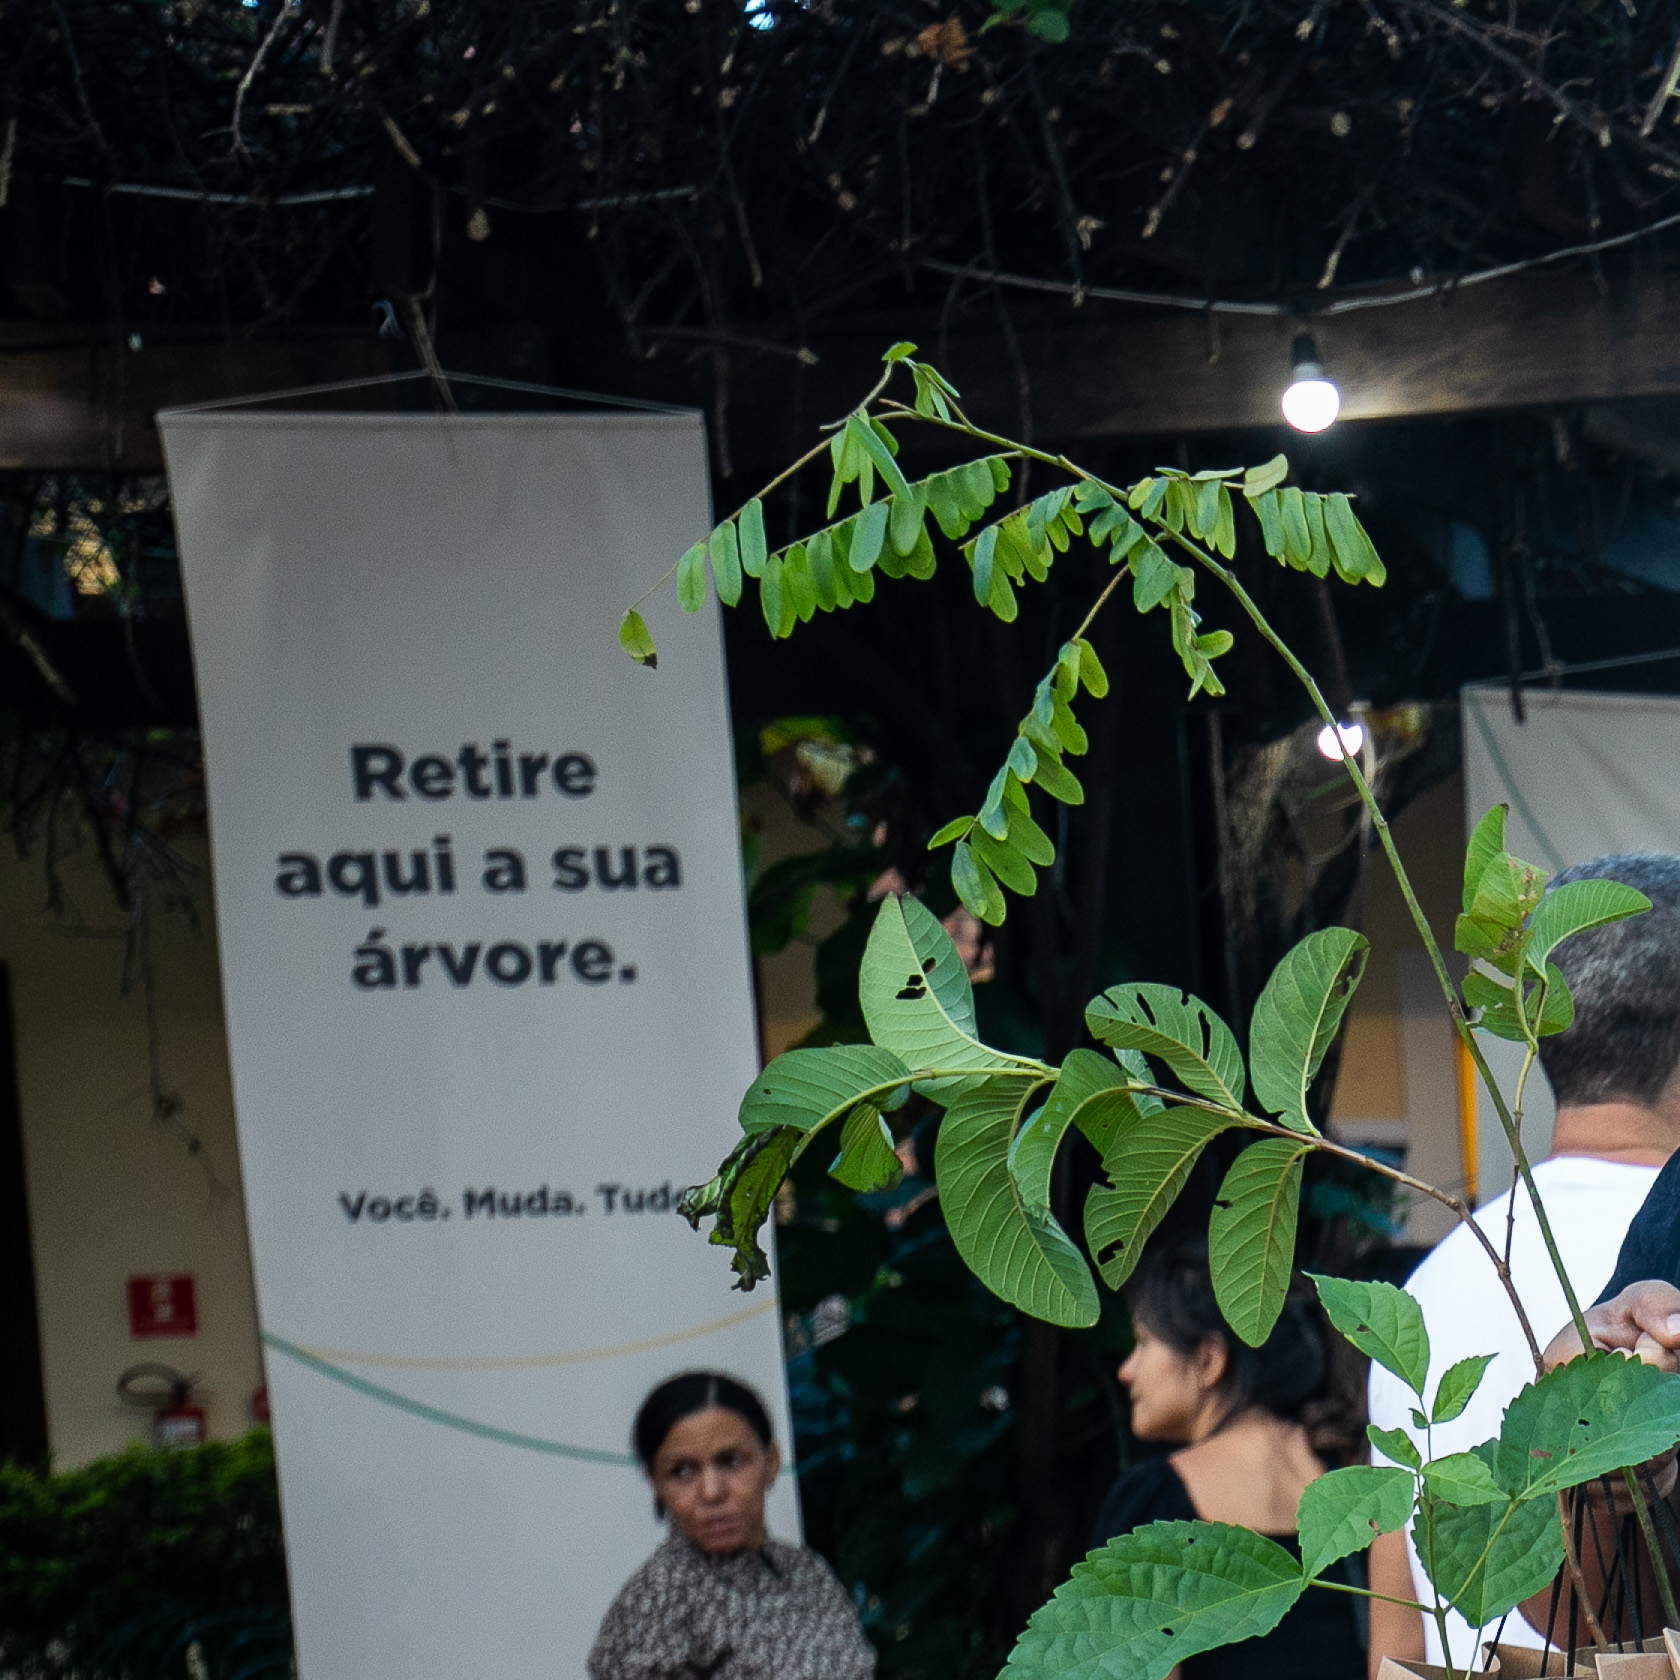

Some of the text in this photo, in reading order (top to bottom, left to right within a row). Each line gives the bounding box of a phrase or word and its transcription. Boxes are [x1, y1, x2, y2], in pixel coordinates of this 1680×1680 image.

[349, 739, 598, 801] Retire
[274, 833, 682, 907] aqui a sua
[351, 925, 638, 989] árvore.
[338, 1183, 451, 1223] Você.
[463, 1183, 585, 1217] Muda.
